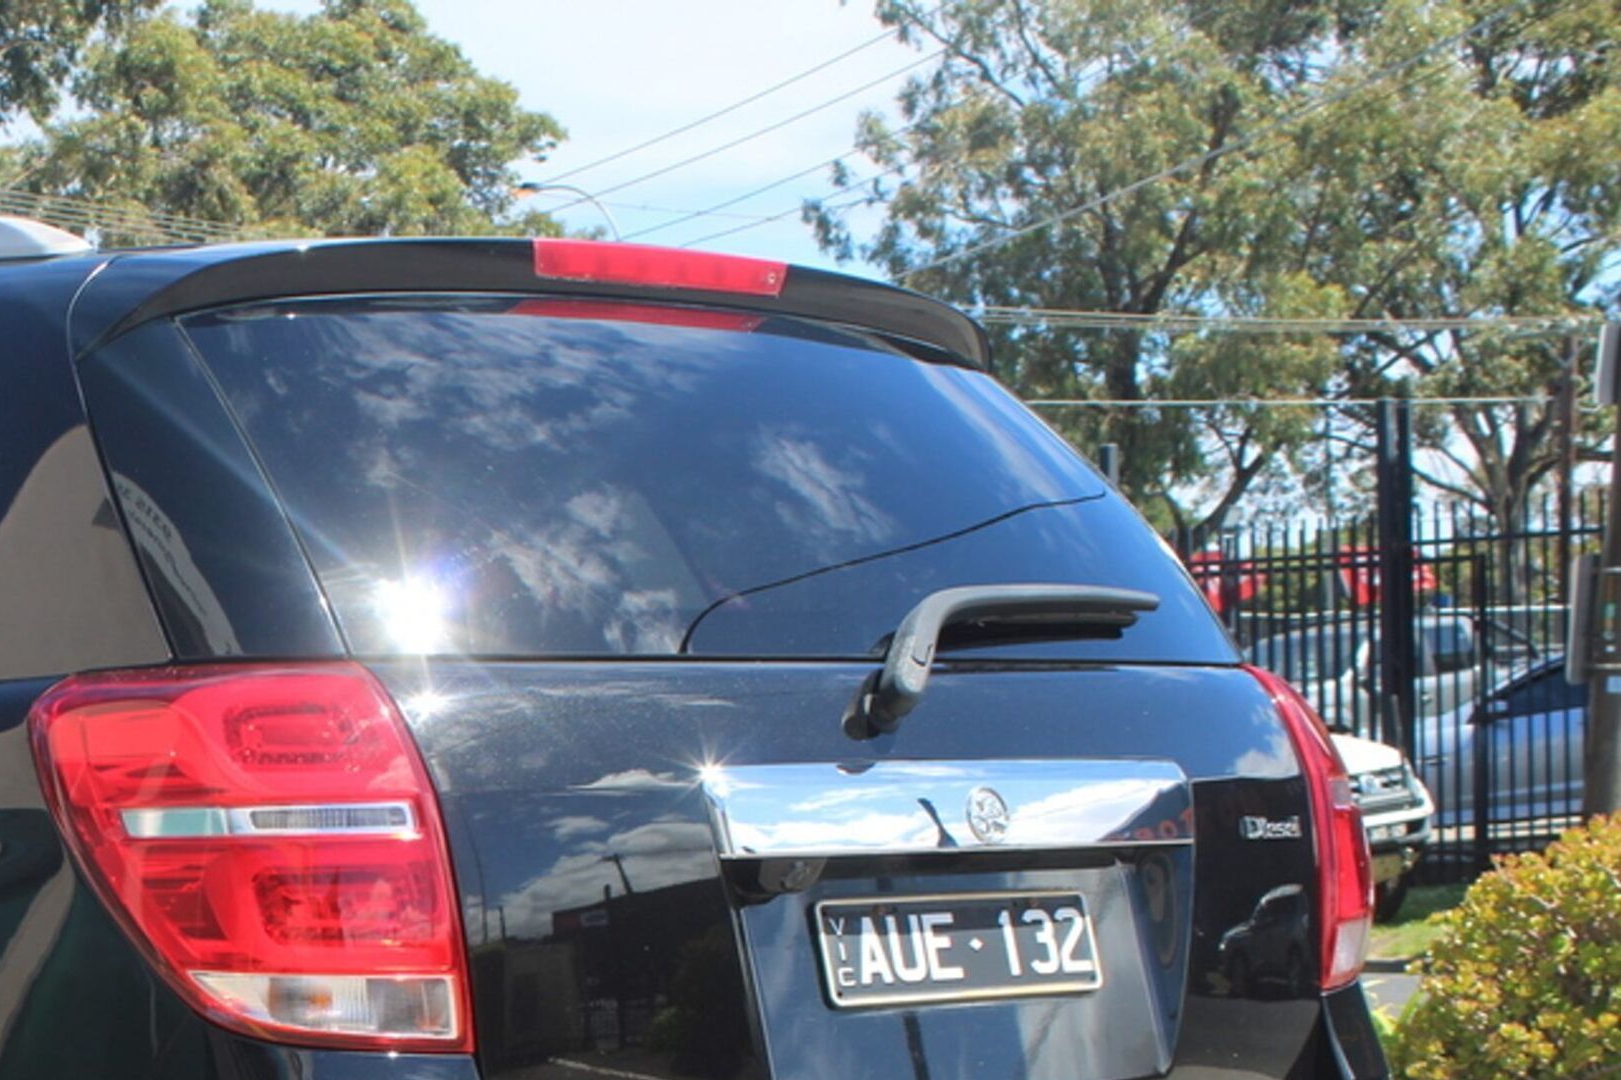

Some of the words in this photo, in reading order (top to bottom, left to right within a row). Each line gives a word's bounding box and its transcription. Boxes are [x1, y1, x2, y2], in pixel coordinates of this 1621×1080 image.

[828, 917, 857, 986] VIC
[861, 912, 964, 985] AUE
[998, 907, 1094, 976] 132
